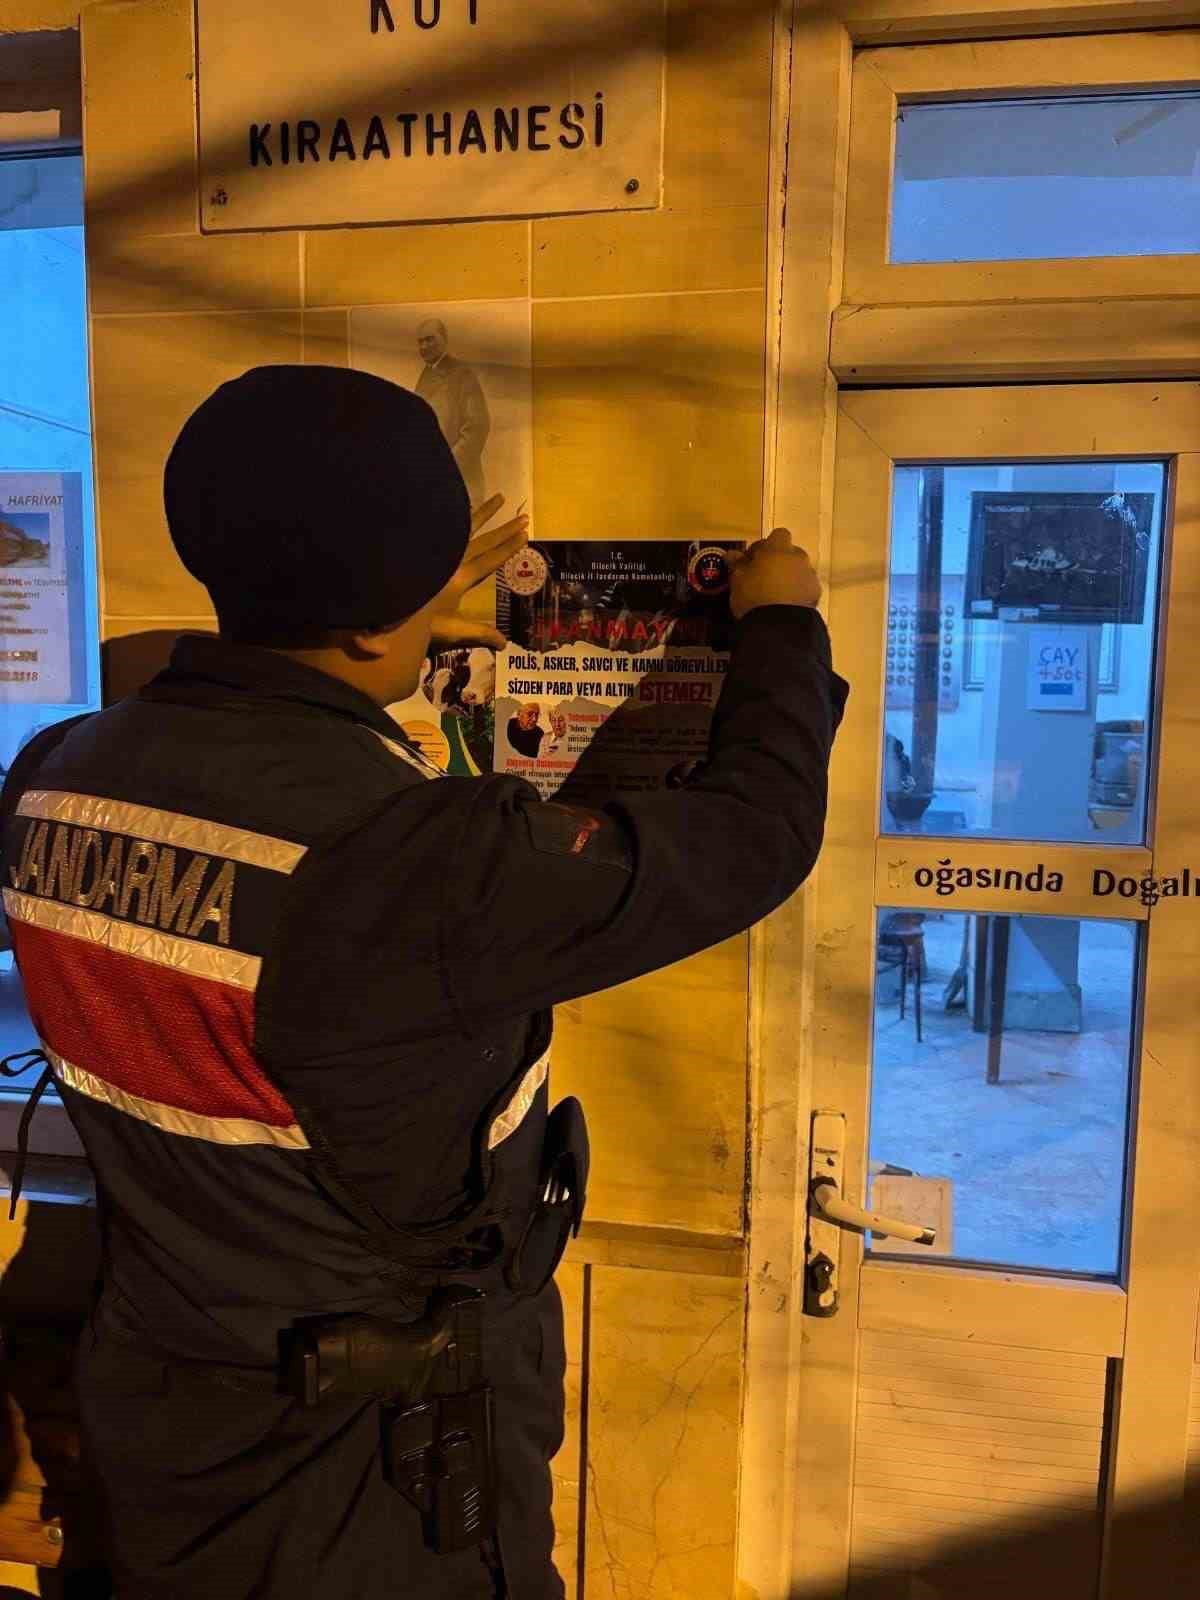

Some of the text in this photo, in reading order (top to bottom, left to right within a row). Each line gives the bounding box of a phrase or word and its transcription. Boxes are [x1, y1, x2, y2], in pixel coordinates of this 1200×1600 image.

[248, 91, 604, 167] KIRAATHANESİ
[508, 654, 540, 672] POLİS,
[543, 656, 579, 672] ASKER,
[582, 657, 613, 672] SAVCI
[616, 657, 629, 672] VE
[632, 658, 664, 673] KAMU
[508, 678, 543, 695] SİZDEN
[546, 681, 574, 696] PARA
[576, 682, 602, 697] VEYA
[605, 682, 634, 698] ALTIN
[9, 819, 236, 944] JANDARMA
